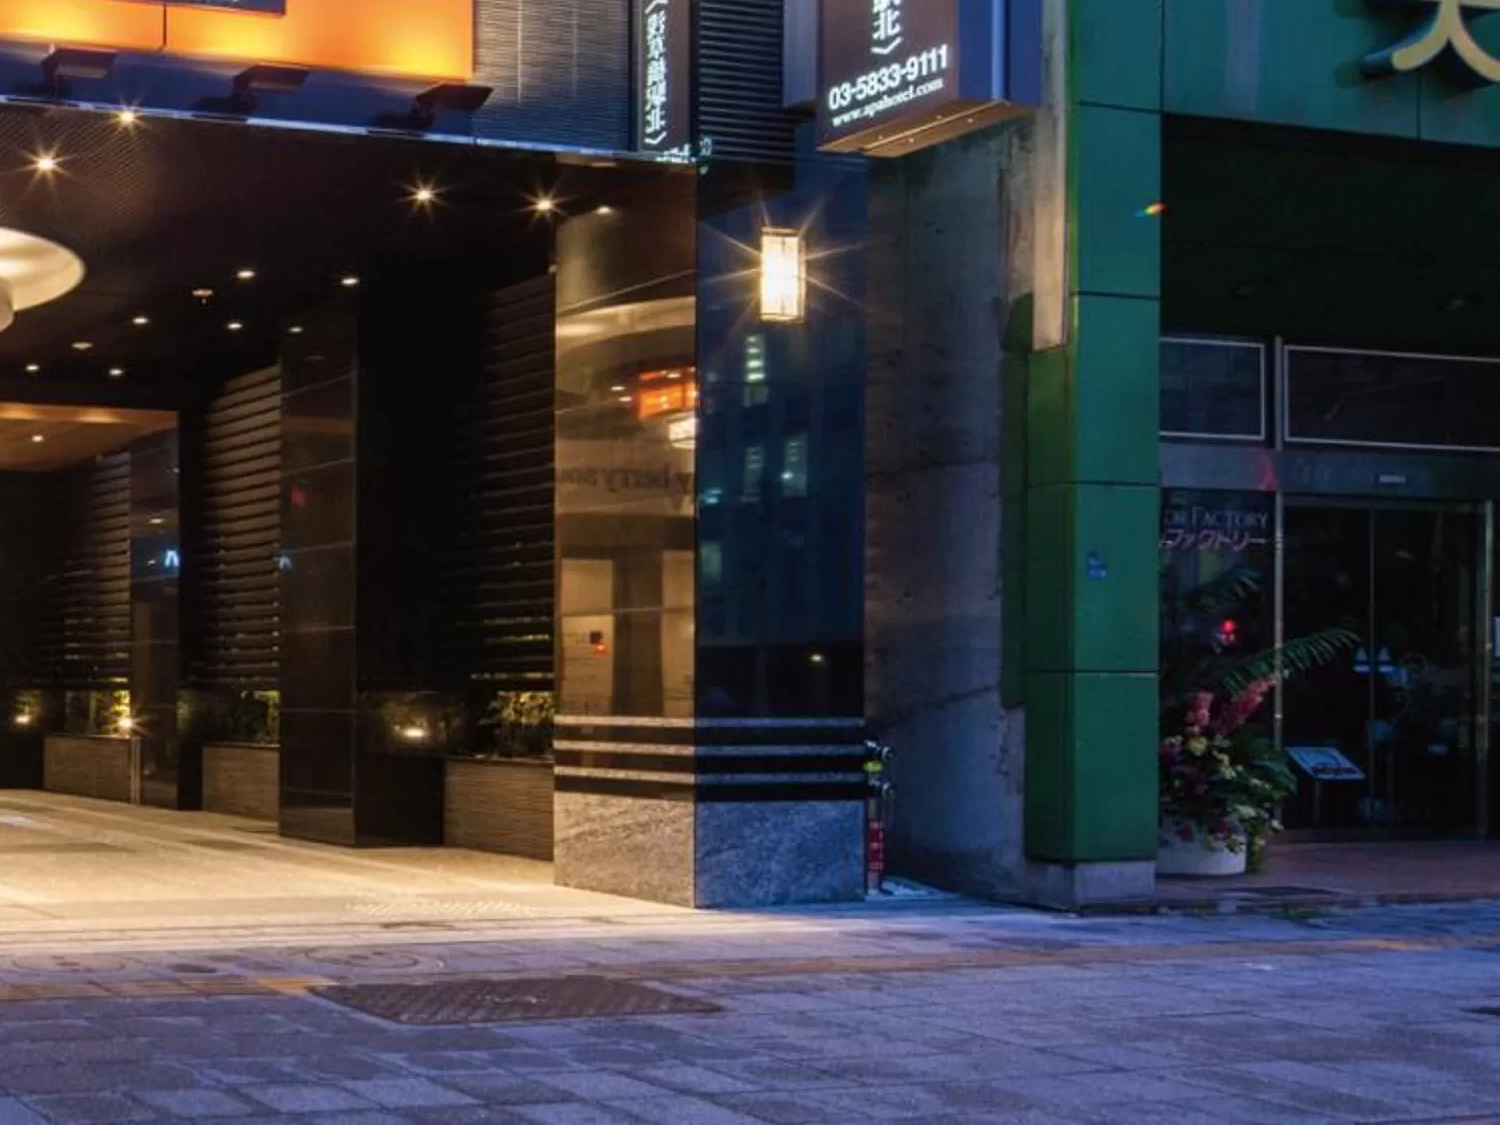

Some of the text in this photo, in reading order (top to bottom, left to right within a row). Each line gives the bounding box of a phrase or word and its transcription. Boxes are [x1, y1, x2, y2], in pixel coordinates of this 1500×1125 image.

[828, 44, 948, 111] 03-5833-9111
[1158, 528, 1269, 552] ファクトリー
